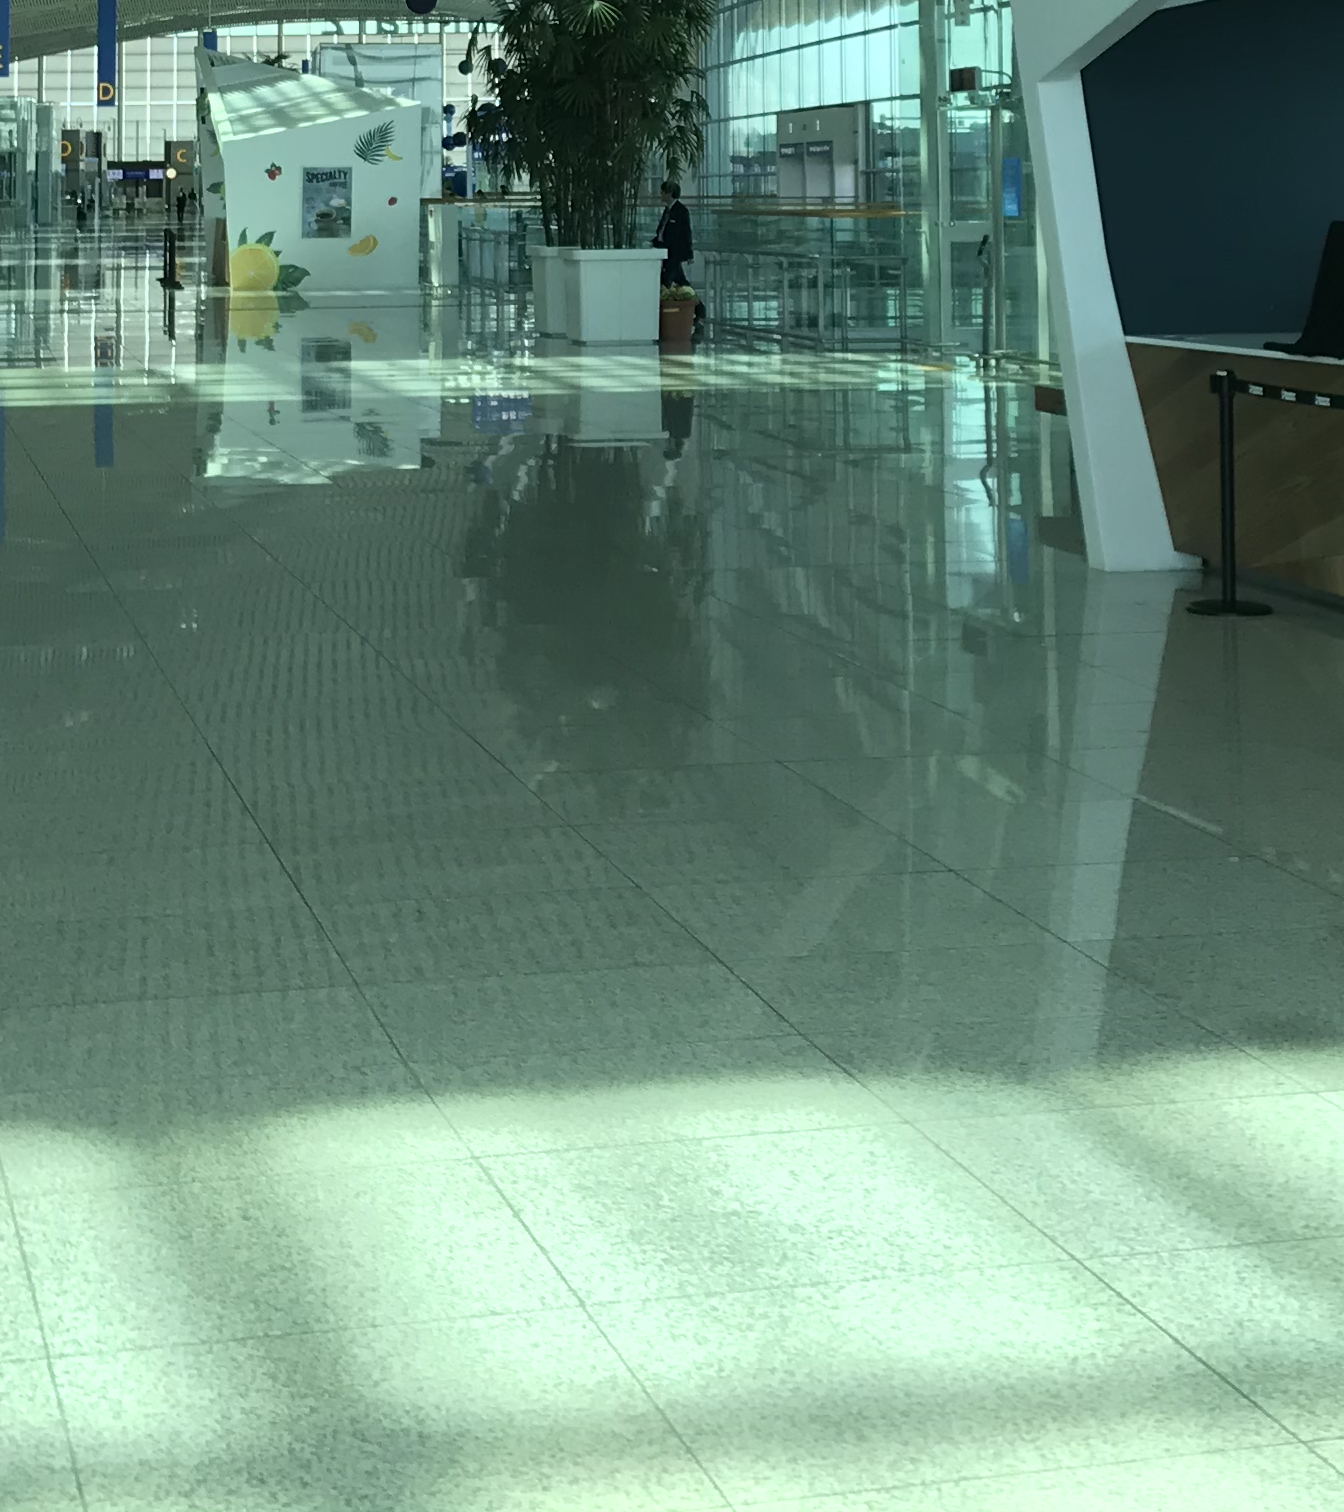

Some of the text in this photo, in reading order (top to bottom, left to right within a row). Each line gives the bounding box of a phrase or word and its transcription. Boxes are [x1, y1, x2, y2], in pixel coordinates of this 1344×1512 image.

[99, 83, 114, 100] D
[176, 148, 187, 163] C
[305, 170, 348, 184] SPECIALTY
